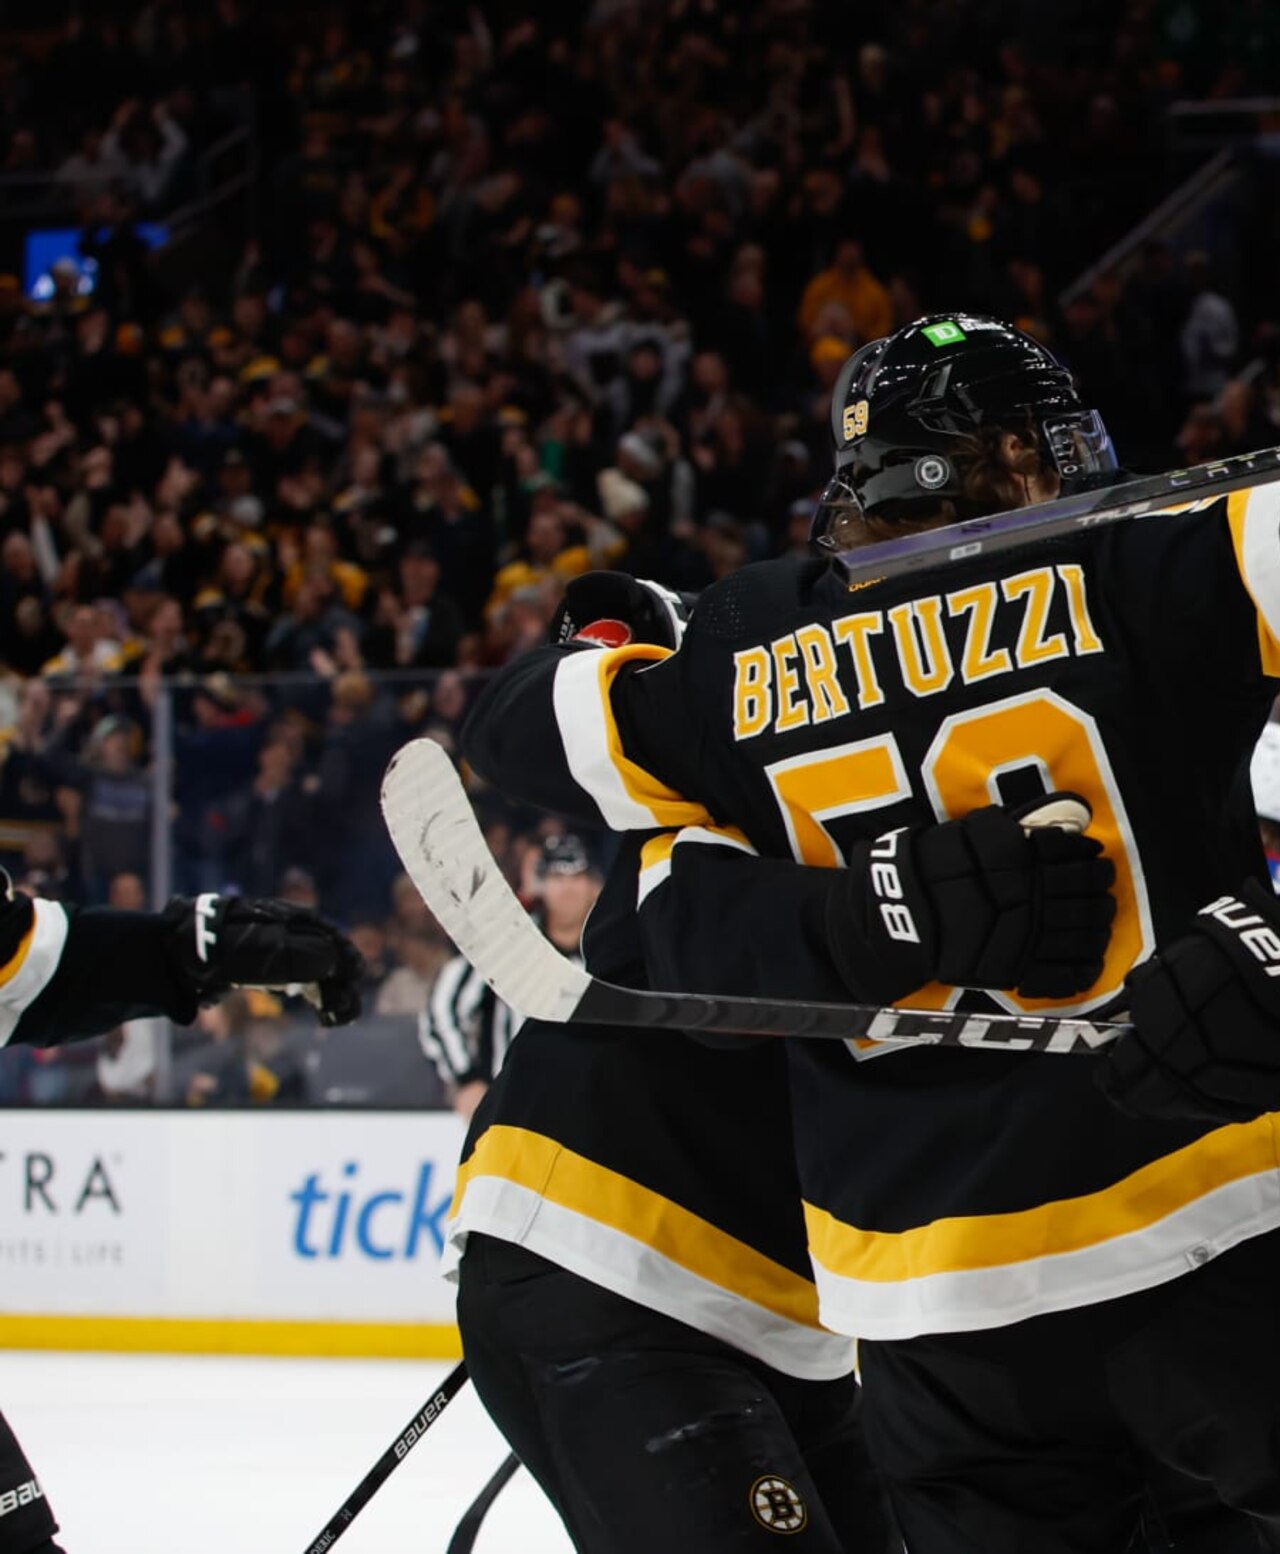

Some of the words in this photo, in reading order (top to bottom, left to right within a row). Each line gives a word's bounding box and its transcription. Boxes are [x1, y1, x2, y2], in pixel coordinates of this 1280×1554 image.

[843, 400, 869, 441] 59
[733, 563, 1104, 741] BERTUZZI
[866, 1007, 1135, 1053] CCM
